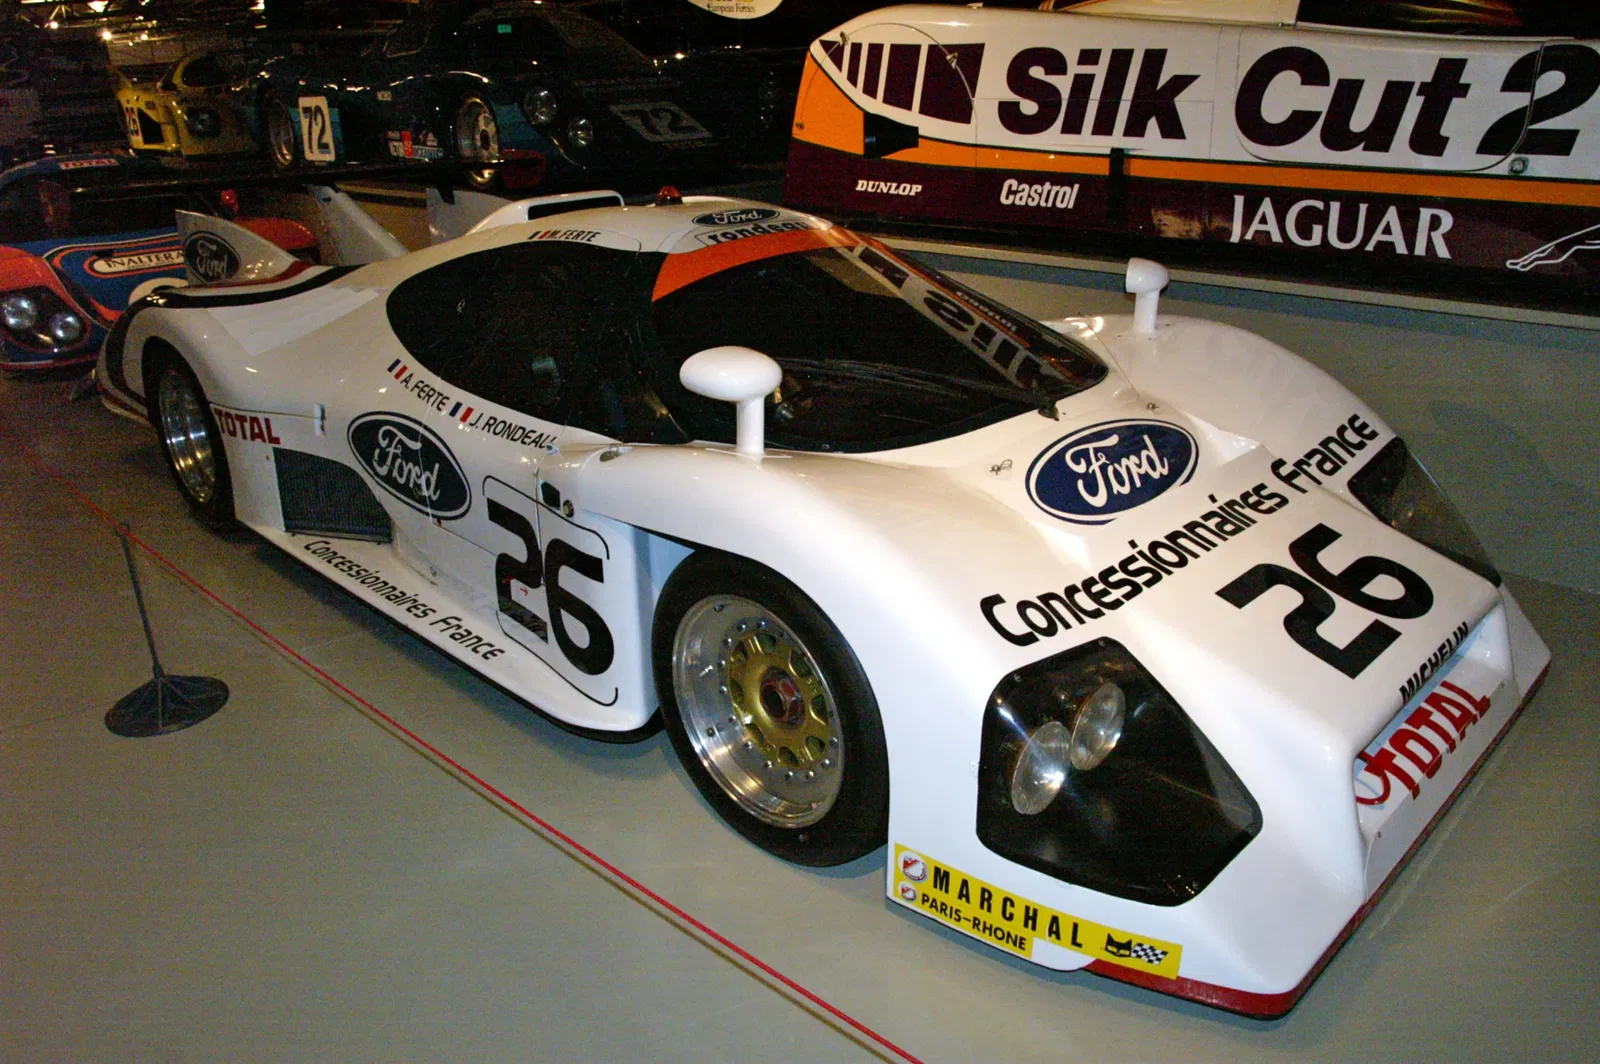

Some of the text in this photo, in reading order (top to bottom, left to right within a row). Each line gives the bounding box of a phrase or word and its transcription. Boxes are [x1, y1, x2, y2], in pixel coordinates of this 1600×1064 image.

[302, 105, 330, 151] 72
[619, 107, 698, 135] 72
[998, 44, 1600, 157] Silk Cut 2
[59, 158, 119, 169] TOTAL
[856, 179, 922, 196] DUNLOP
[1000, 178, 1080, 209] Castrol
[549, 228, 602, 243] M.FERTE
[713, 210, 762, 224] Ford
[1229, 195, 1454, 259] JAGUAR
[106, 251, 184, 268] INALTERA
[197, 240, 228, 278] Ford
[401, 373, 450, 411] A.FERTE
[214, 408, 280, 444] TOTAL
[373, 425, 440, 501] Ford
[1065, 434, 1169, 508] Ford
[980, 413, 1379, 646] Concessionnaires France
[304, 540, 506, 660] Concessionnaires France
[487, 498, 614, 675] 26
[1214, 523, 1434, 680] 26
[1399, 621, 1469, 704] MICHELIN
[1358, 680, 1491, 803] TOTAL
[921, 892, 1026, 952] PARIS-RHONE
[933, 866, 1083, 949] MARCHAL
